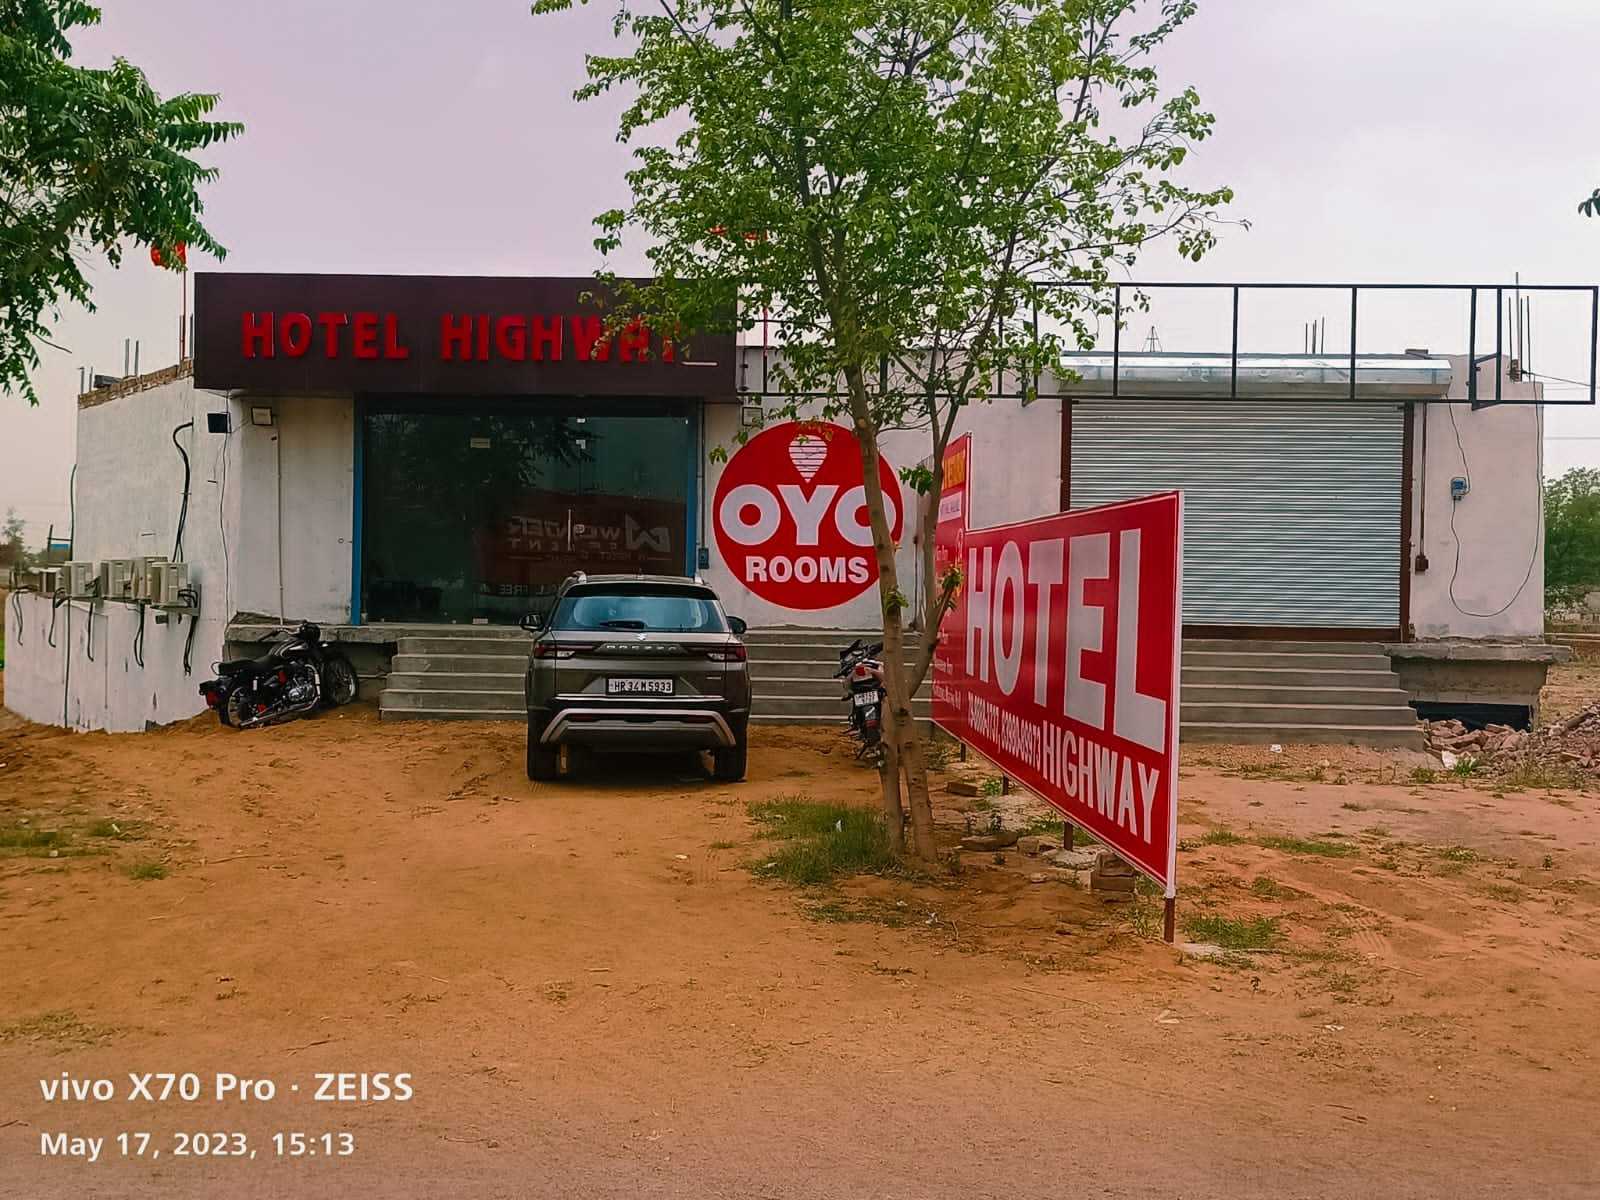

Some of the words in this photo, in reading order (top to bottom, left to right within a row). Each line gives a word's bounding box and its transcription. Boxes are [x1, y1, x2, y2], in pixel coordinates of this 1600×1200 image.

[241, 311, 408, 360] HOTEL
[719, 484, 897, 547] OYO
[745, 555, 869, 584] ROOMS
[965, 528, 1167, 755] HOTEL
[1042, 720, 1160, 845] HIGHWAY
